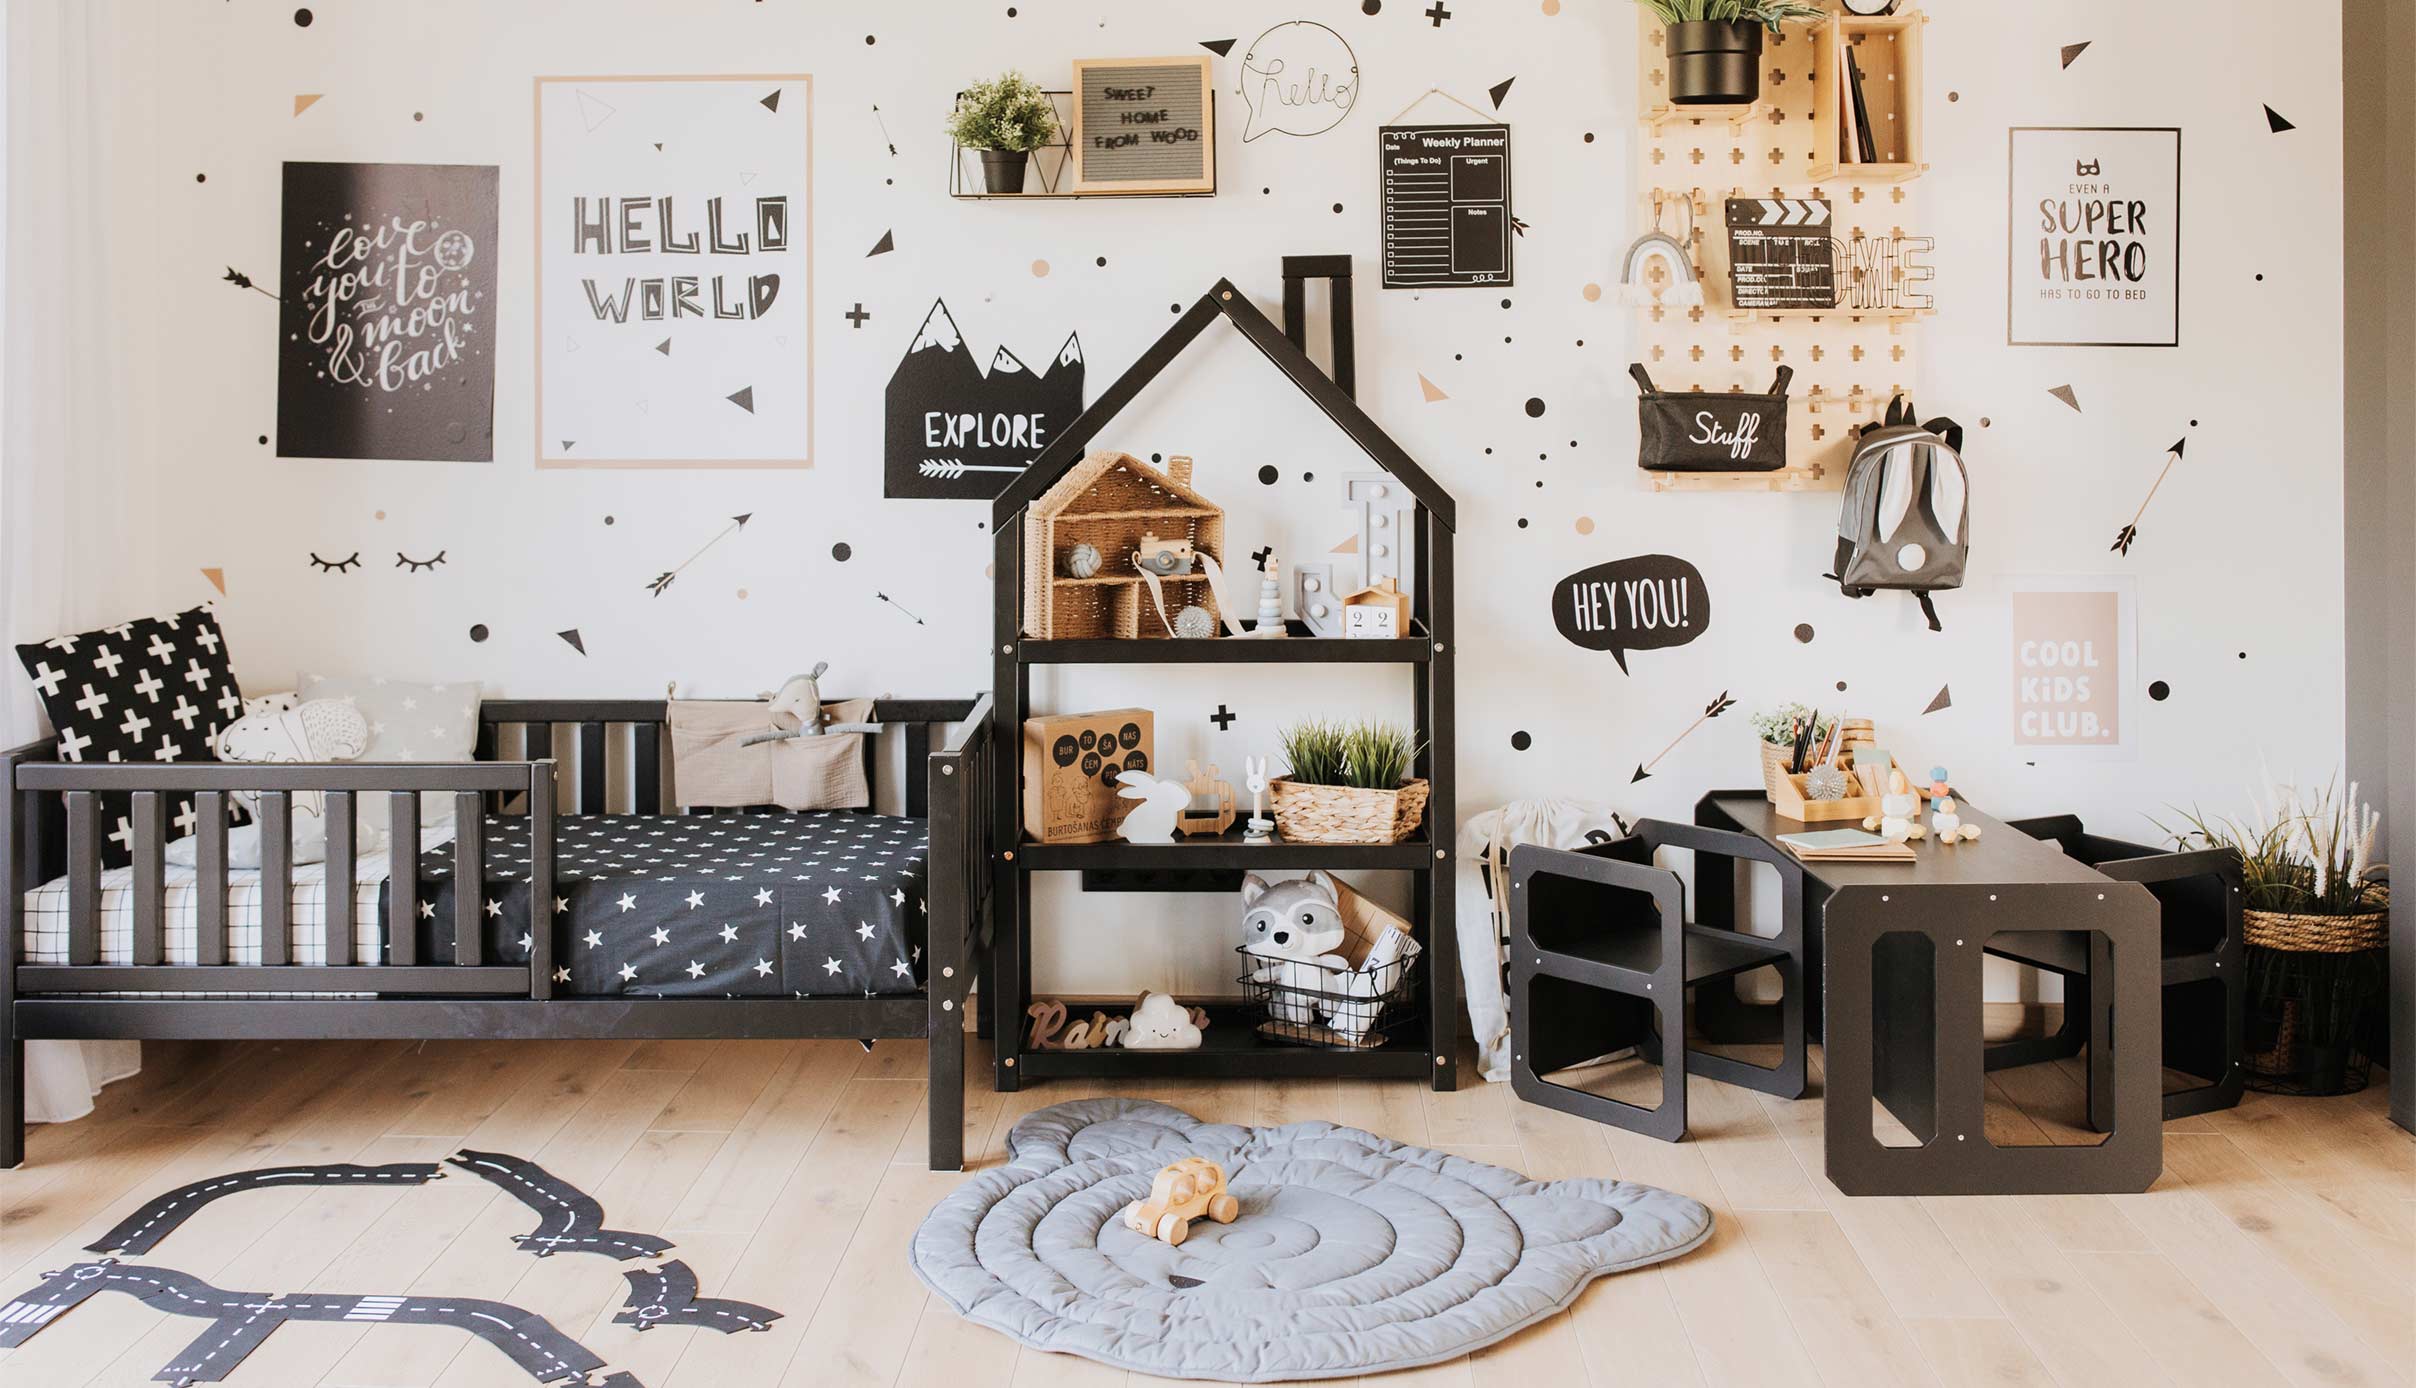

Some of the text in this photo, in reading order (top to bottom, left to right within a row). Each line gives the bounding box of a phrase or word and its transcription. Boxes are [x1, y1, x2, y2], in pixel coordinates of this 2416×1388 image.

[1103, 85, 1155, 101] SWEET
[1120, 109, 1169, 124] HOME
[1094, 127, 1198, 149] FROM WOOD
[1422, 137, 1505, 149] Weekly Planner
[1393, 157, 1442, 166] (Things To Do)
[1466, 157, 1489, 166] Urgent
[2069, 183, 2111, 194] EVEN A
[573, 195, 788, 255] HELLO
[1467, 208, 1488, 216] Notes
[2039, 198, 2147, 235] SUPER
[309, 215, 430, 273] love
[2040, 237, 2146, 283] HERO
[302, 242, 446, 344] you to
[581, 272, 781, 324] WORLD
[2040, 289, 2147, 300] HAS TO GO TO BED
[360, 289, 476, 348] moon
[329, 316, 467, 392] & back
[924, 411, 1046, 449] EXPLORE
[1688, 410, 1761, 460] Stuff
[1572, 576, 1689, 632] HEY YOU!
[2020, 640, 2099, 668] COOL
[2020, 710, 2110, 737] CLUB.
[1058, 731, 1137, 756] BUR TO ŠA NAS
[1084, 758, 1099, 769] ČEM
